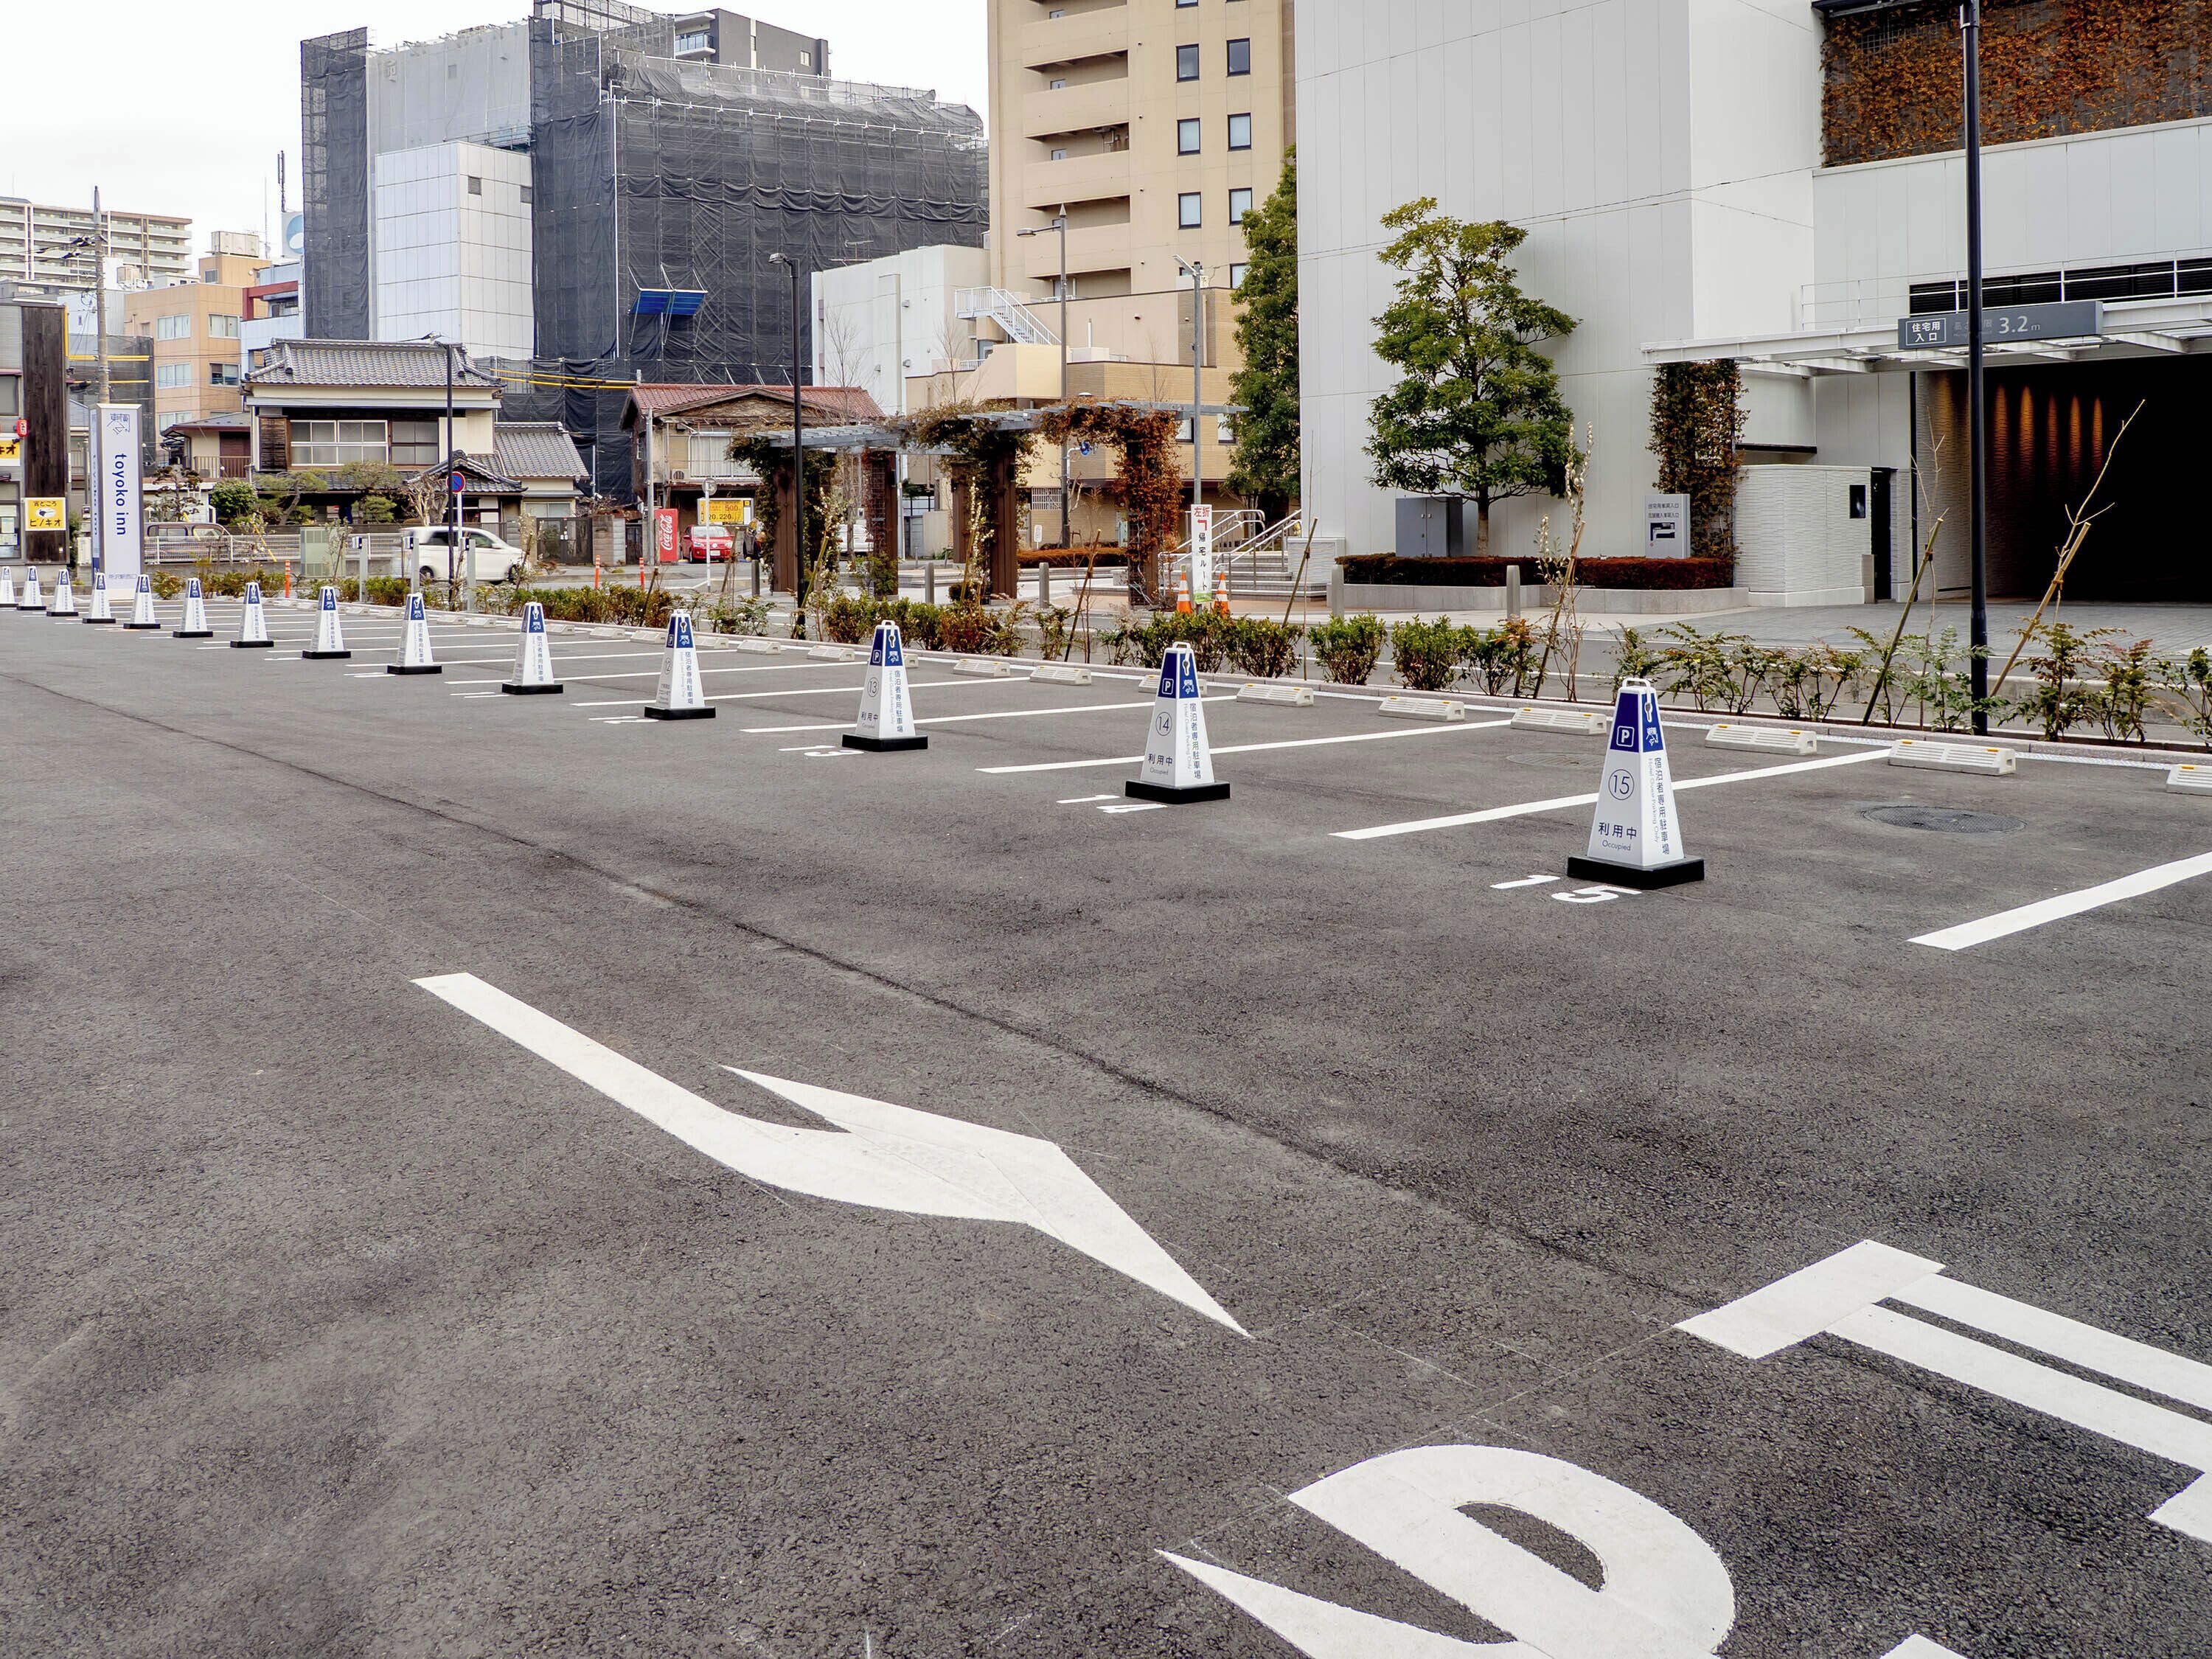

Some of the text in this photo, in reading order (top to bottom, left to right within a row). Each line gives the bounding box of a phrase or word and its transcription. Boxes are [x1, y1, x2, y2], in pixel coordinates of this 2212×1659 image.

[1912, 321, 1941, 332] 住宅用
[1999, 316, 2028, 334] 3.2
[2031, 323, 2040, 331] m
[1915, 333, 1938, 343] 入口
[112, 453, 129, 535] toyoko inn
[1194, 507, 1210, 517] 左折
[869, 681, 877, 694] 13
[1158, 715, 1170, 732] 14
[1147, 753, 1173, 766] 利用中
[1613, 774, 1630, 795] 15
[1598, 821, 1637, 840] 利用中
[1601, 839, 1631, 851] Occupied
[1489, 874, 1642, 902] 15
